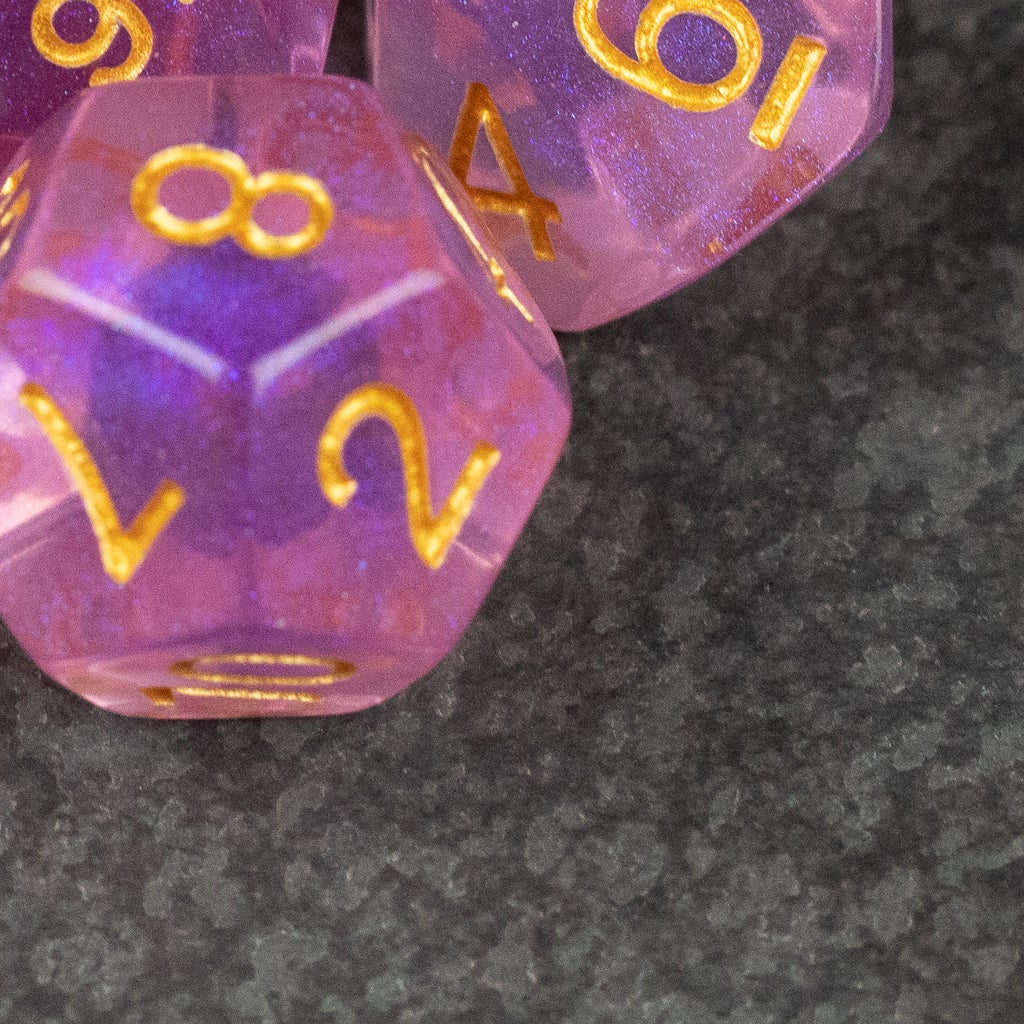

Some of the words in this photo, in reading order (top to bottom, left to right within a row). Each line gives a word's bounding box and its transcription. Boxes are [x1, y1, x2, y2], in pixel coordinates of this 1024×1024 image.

[131, 143, 336, 260] 8
[449, 82, 564, 262] 4
[317, 382, 502, 570] 2
